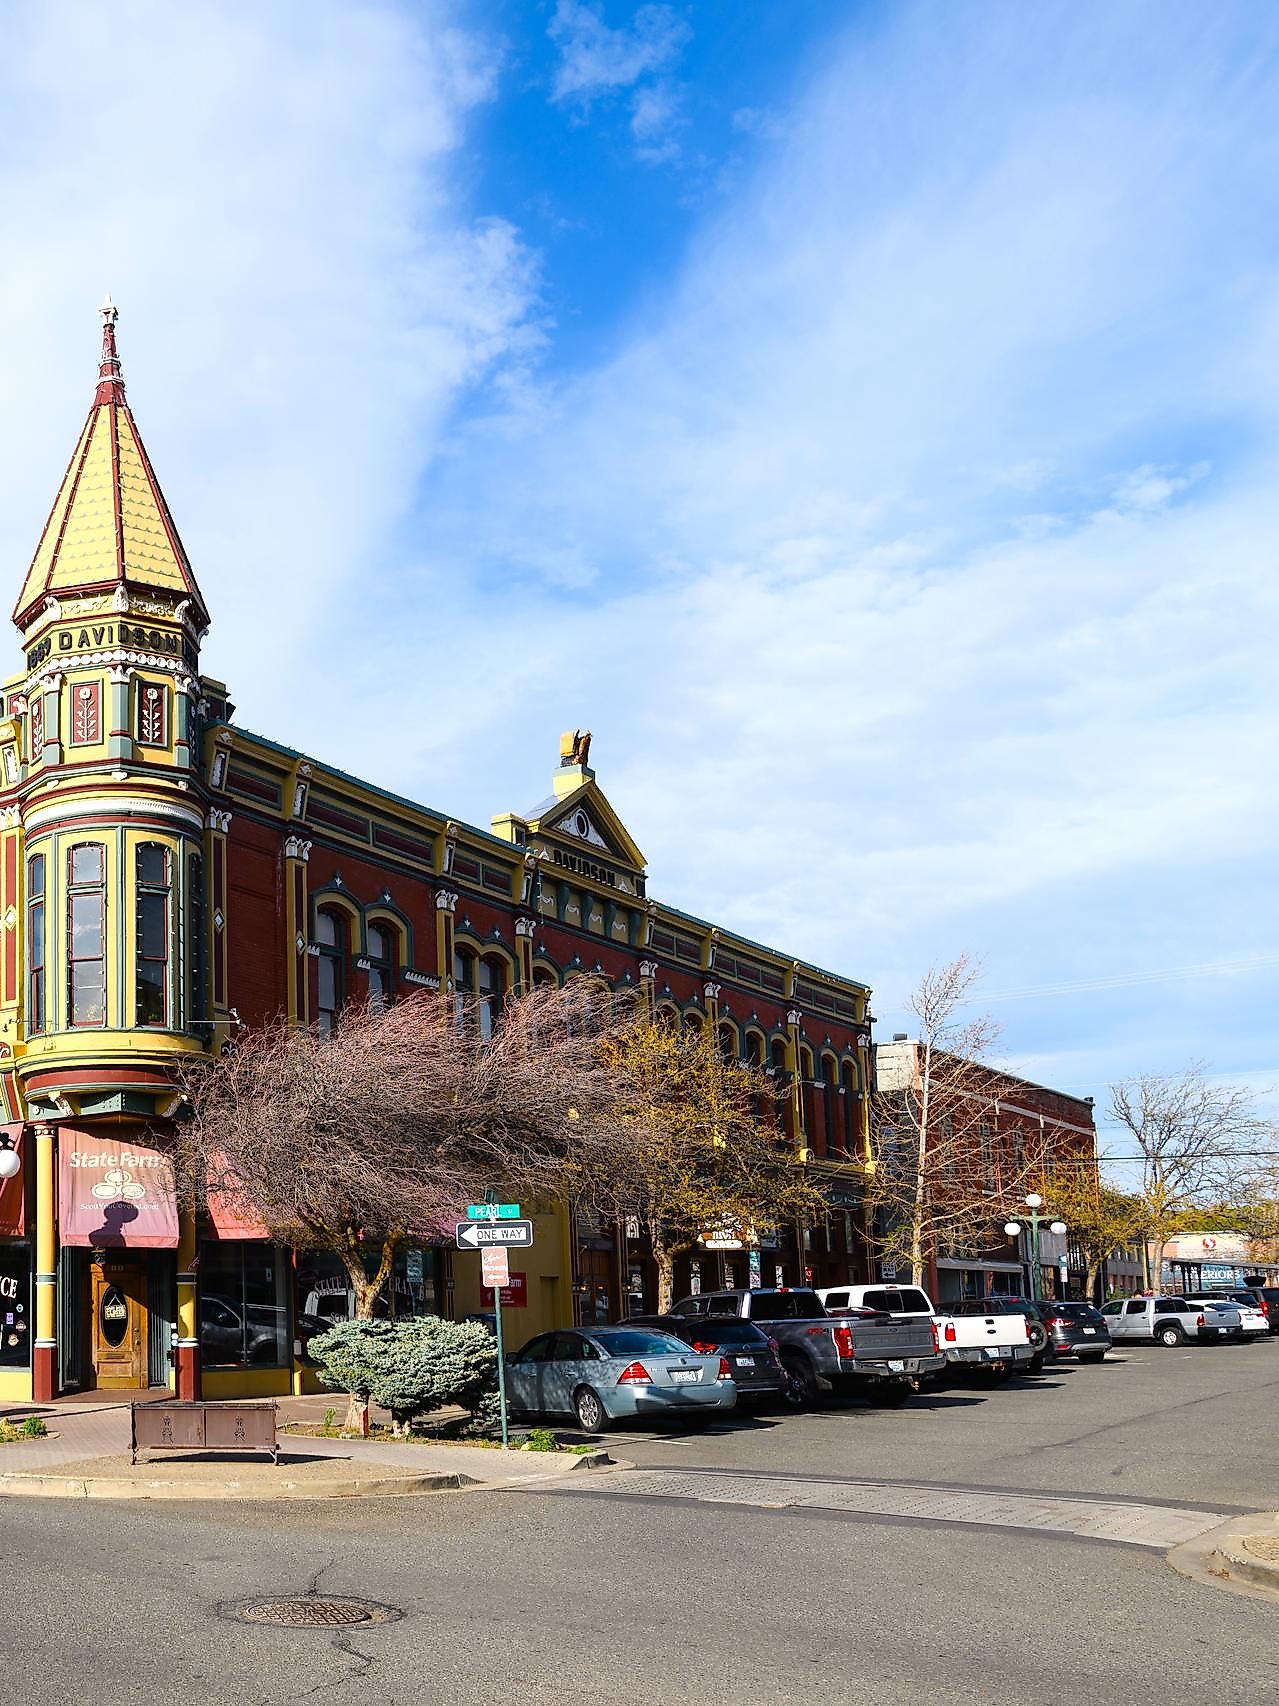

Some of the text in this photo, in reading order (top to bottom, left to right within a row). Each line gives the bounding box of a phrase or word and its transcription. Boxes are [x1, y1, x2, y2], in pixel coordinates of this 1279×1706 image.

[58, 624, 177, 653] DAVIDSON
[69, 1152, 116, 1168] State
[475, 1205, 502, 1218] PEARL
[477, 1229, 523, 1240] ONE WAY
